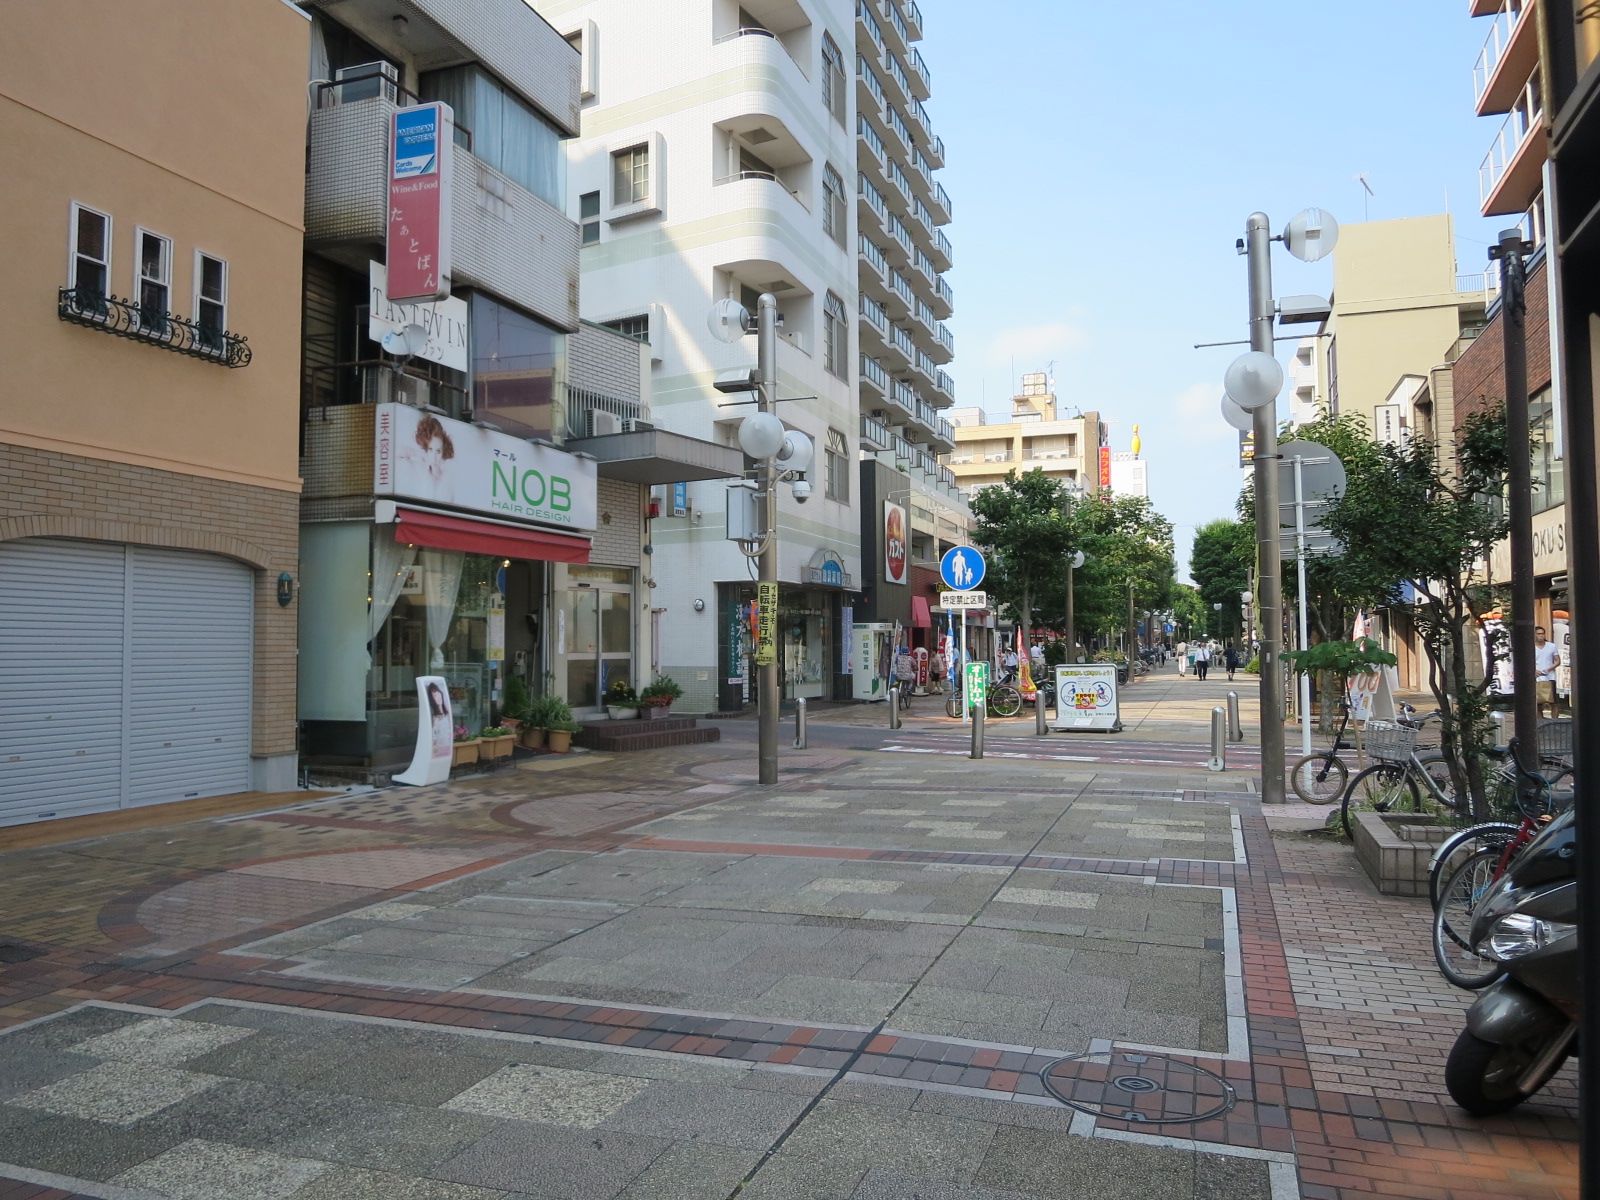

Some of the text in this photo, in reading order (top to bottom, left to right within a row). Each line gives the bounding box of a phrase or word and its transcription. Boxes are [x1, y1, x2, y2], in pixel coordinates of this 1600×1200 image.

[397, 123, 434, 137] AMERICAN
[403, 132, 435, 145] EXPRESS
[396, 160, 413, 168] Cards
[392, 181, 438, 194] Wine&Food
[379, 411, 390, 486] 美容室
[493, 448, 517, 462] マール
[1101, 450, 1110, 485] カラオケ
[491, 459, 572, 512] NOB
[491, 500, 571, 523] HAIR DESIGN
[888, 538, 905, 561] ガスト
[942, 594, 985, 606] 特定禁止区間
